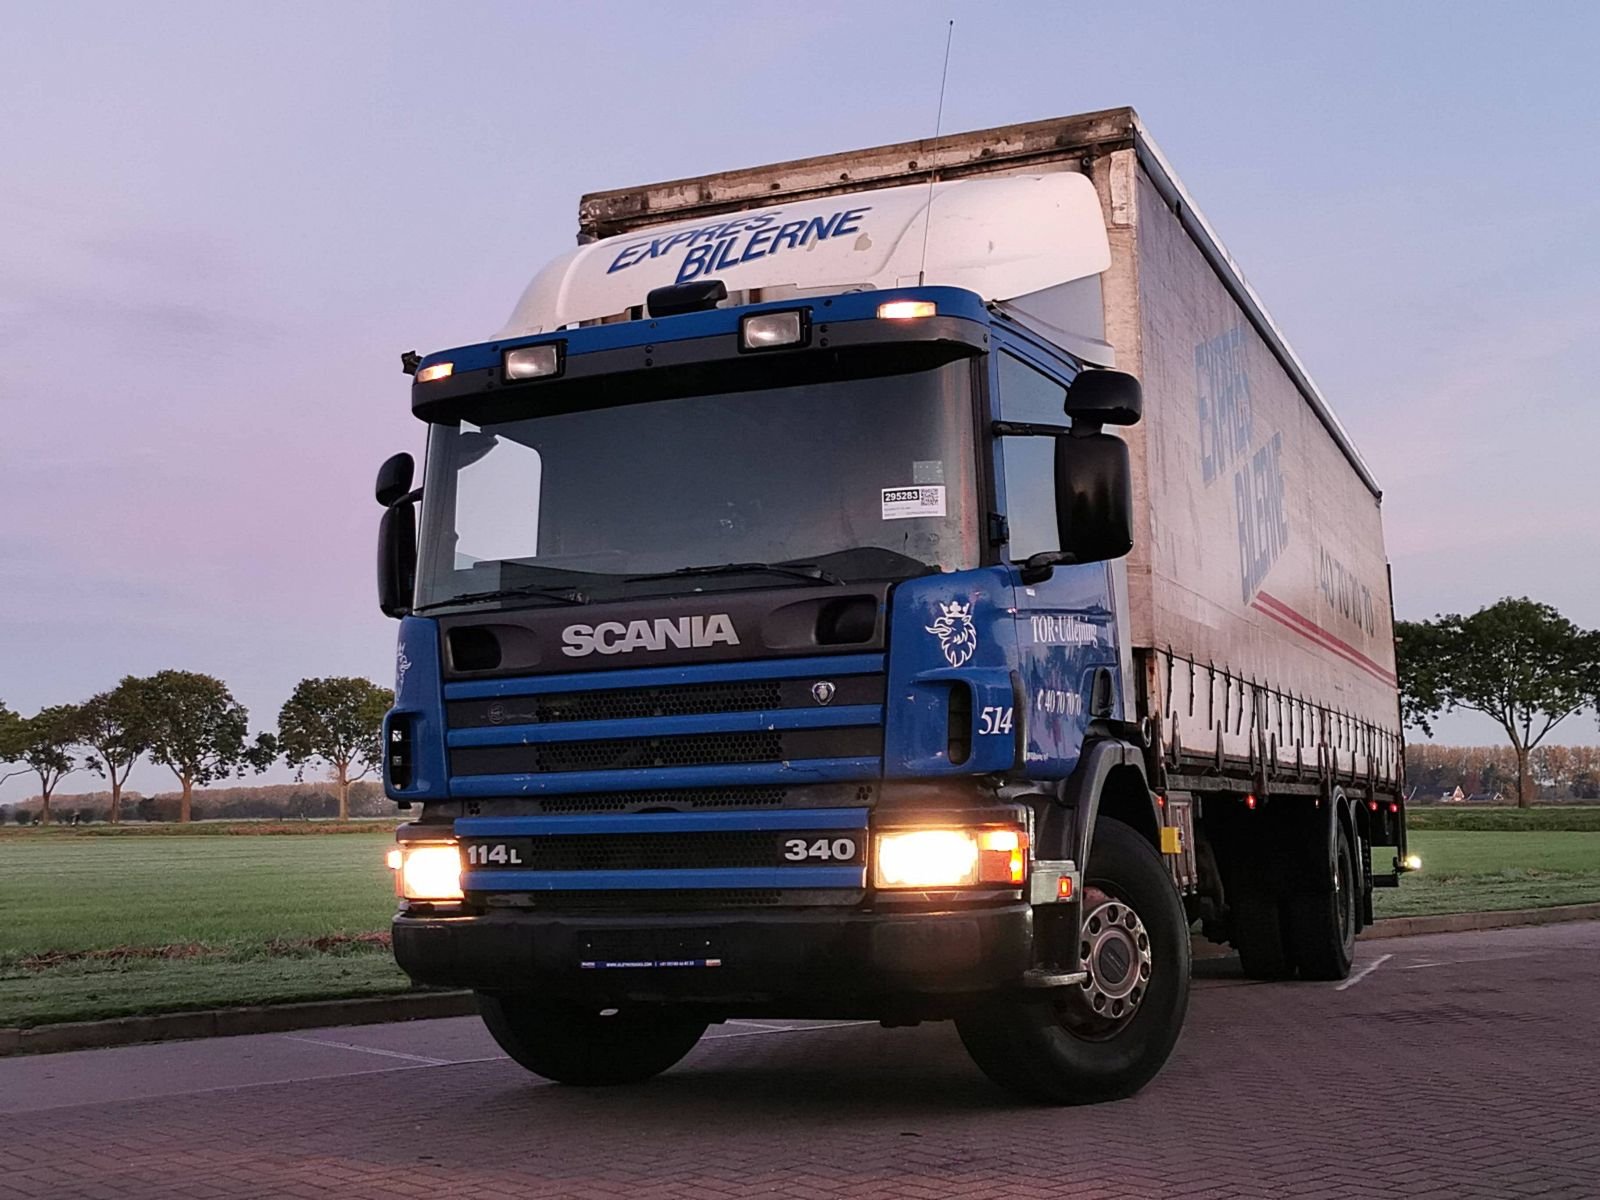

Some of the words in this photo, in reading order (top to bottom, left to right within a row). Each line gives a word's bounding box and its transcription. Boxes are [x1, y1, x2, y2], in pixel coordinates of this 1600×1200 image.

[606, 211, 781, 275] EXPRES
[675, 206, 872, 284] BILERNE
[885, 491, 918, 501] 295283
[1234, 431, 1289, 605] BILERNE
[562, 613, 740, 657] SCANIA
[978, 706, 1013, 735] 514
[784, 838, 856, 861] 340
